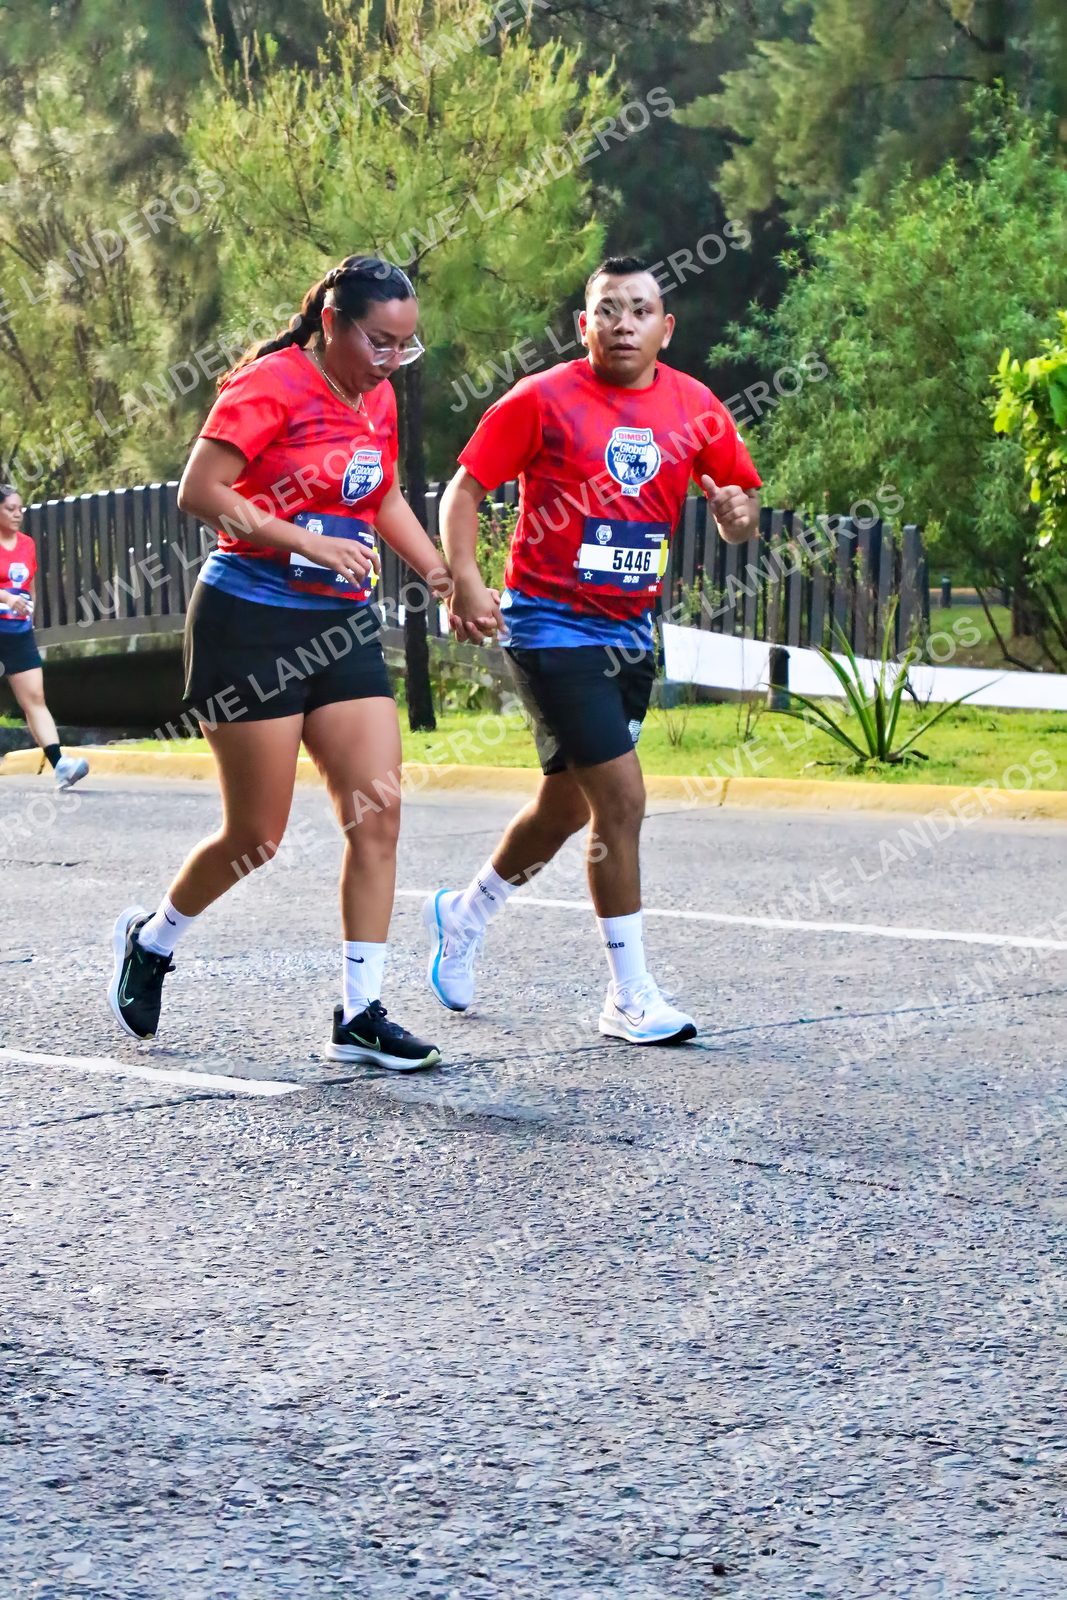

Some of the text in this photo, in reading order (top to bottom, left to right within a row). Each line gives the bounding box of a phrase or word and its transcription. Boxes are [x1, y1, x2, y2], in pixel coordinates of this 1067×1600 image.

[618, 432, 648, 442] BIMBO
[620, 443, 648, 456] Global
[613, 451, 637, 463] Race
[612, 549, 652, 573] 5446
[606, 940, 625, 949] das
